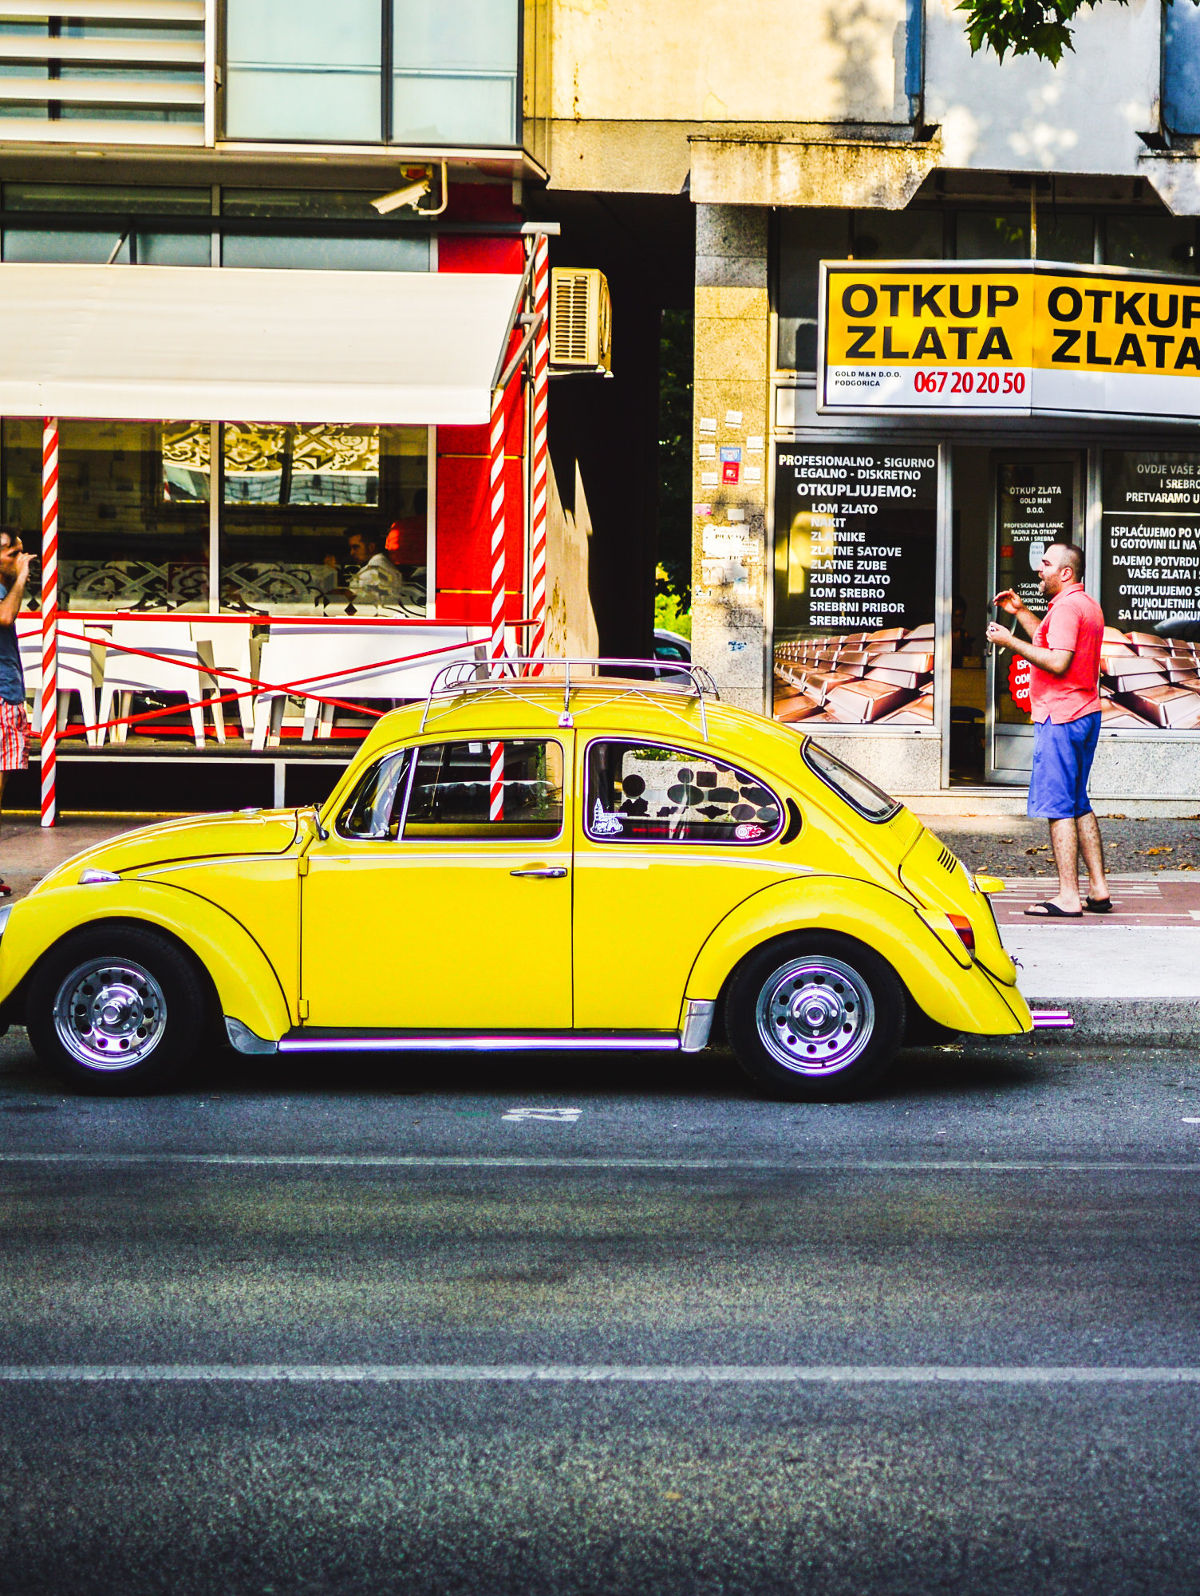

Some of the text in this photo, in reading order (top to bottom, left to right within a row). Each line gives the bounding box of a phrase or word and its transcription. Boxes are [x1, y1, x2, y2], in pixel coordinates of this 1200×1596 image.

[842, 284, 1018, 318] OTKUP
[845, 326, 1013, 360] ZLATA
[914, 371, 1025, 394] 067 20 20 50
[778, 455, 874, 467] PROFESIONALNO
[884, 457, 935, 468] SIGURNO
[794, 468, 847, 479] LEGALNO
[857, 469, 921, 480] DISKRETNO
[1137, 464, 1167, 474] OVDJE
[1170, 463, 1194, 475] VAŠE
[797, 483, 917, 497] OTKUPLJUJEMO:
[1010, 486, 1062, 495] OTKUP ZLATA
[1126, 492, 1190, 504] PRETVARAMO
[1193, 493, 1200, 504] U
[812, 503, 878, 514] LOM ZLATO
[811, 518, 846, 528] NAKIT
[811, 531, 865, 542] ZLATNIKE
[1111, 524, 1176, 537] ISPLAĆUJEMO
[1179, 528, 1192, 538] PO
[1111, 539, 1118, 548] U
[1120, 539, 1167, 550] GOTOVINI
[1169, 540, 1180, 550] ILI
[1182, 540, 1197, 550] NA
[810, 545, 902, 557] ZLATNE SATOVE
[810, 560, 887, 571] ZLATNE ZUBE
[1112, 555, 1152, 566] DAJEMO
[1155, 556, 1199, 567] POTVRDU
[1127, 566, 1159, 579] VAŠEG
[1161, 569, 1191, 580] ZLATA
[1193, 570, 1196, 579] I
[810, 574, 890, 585] ZUBNO ZLATO
[810, 588, 885, 599] LOM SREBRO
[1119, 585, 1192, 596] OTKUPLJUJEMO
[809, 602, 905, 613] SREBRNI PRIBOR
[1131, 598, 1195, 609] PUNOLJETNIH
[1118, 610, 1132, 620] SA
[1134, 608, 1167, 621] LIČNIM
[809, 615, 883, 627] SREBRNJAKE
